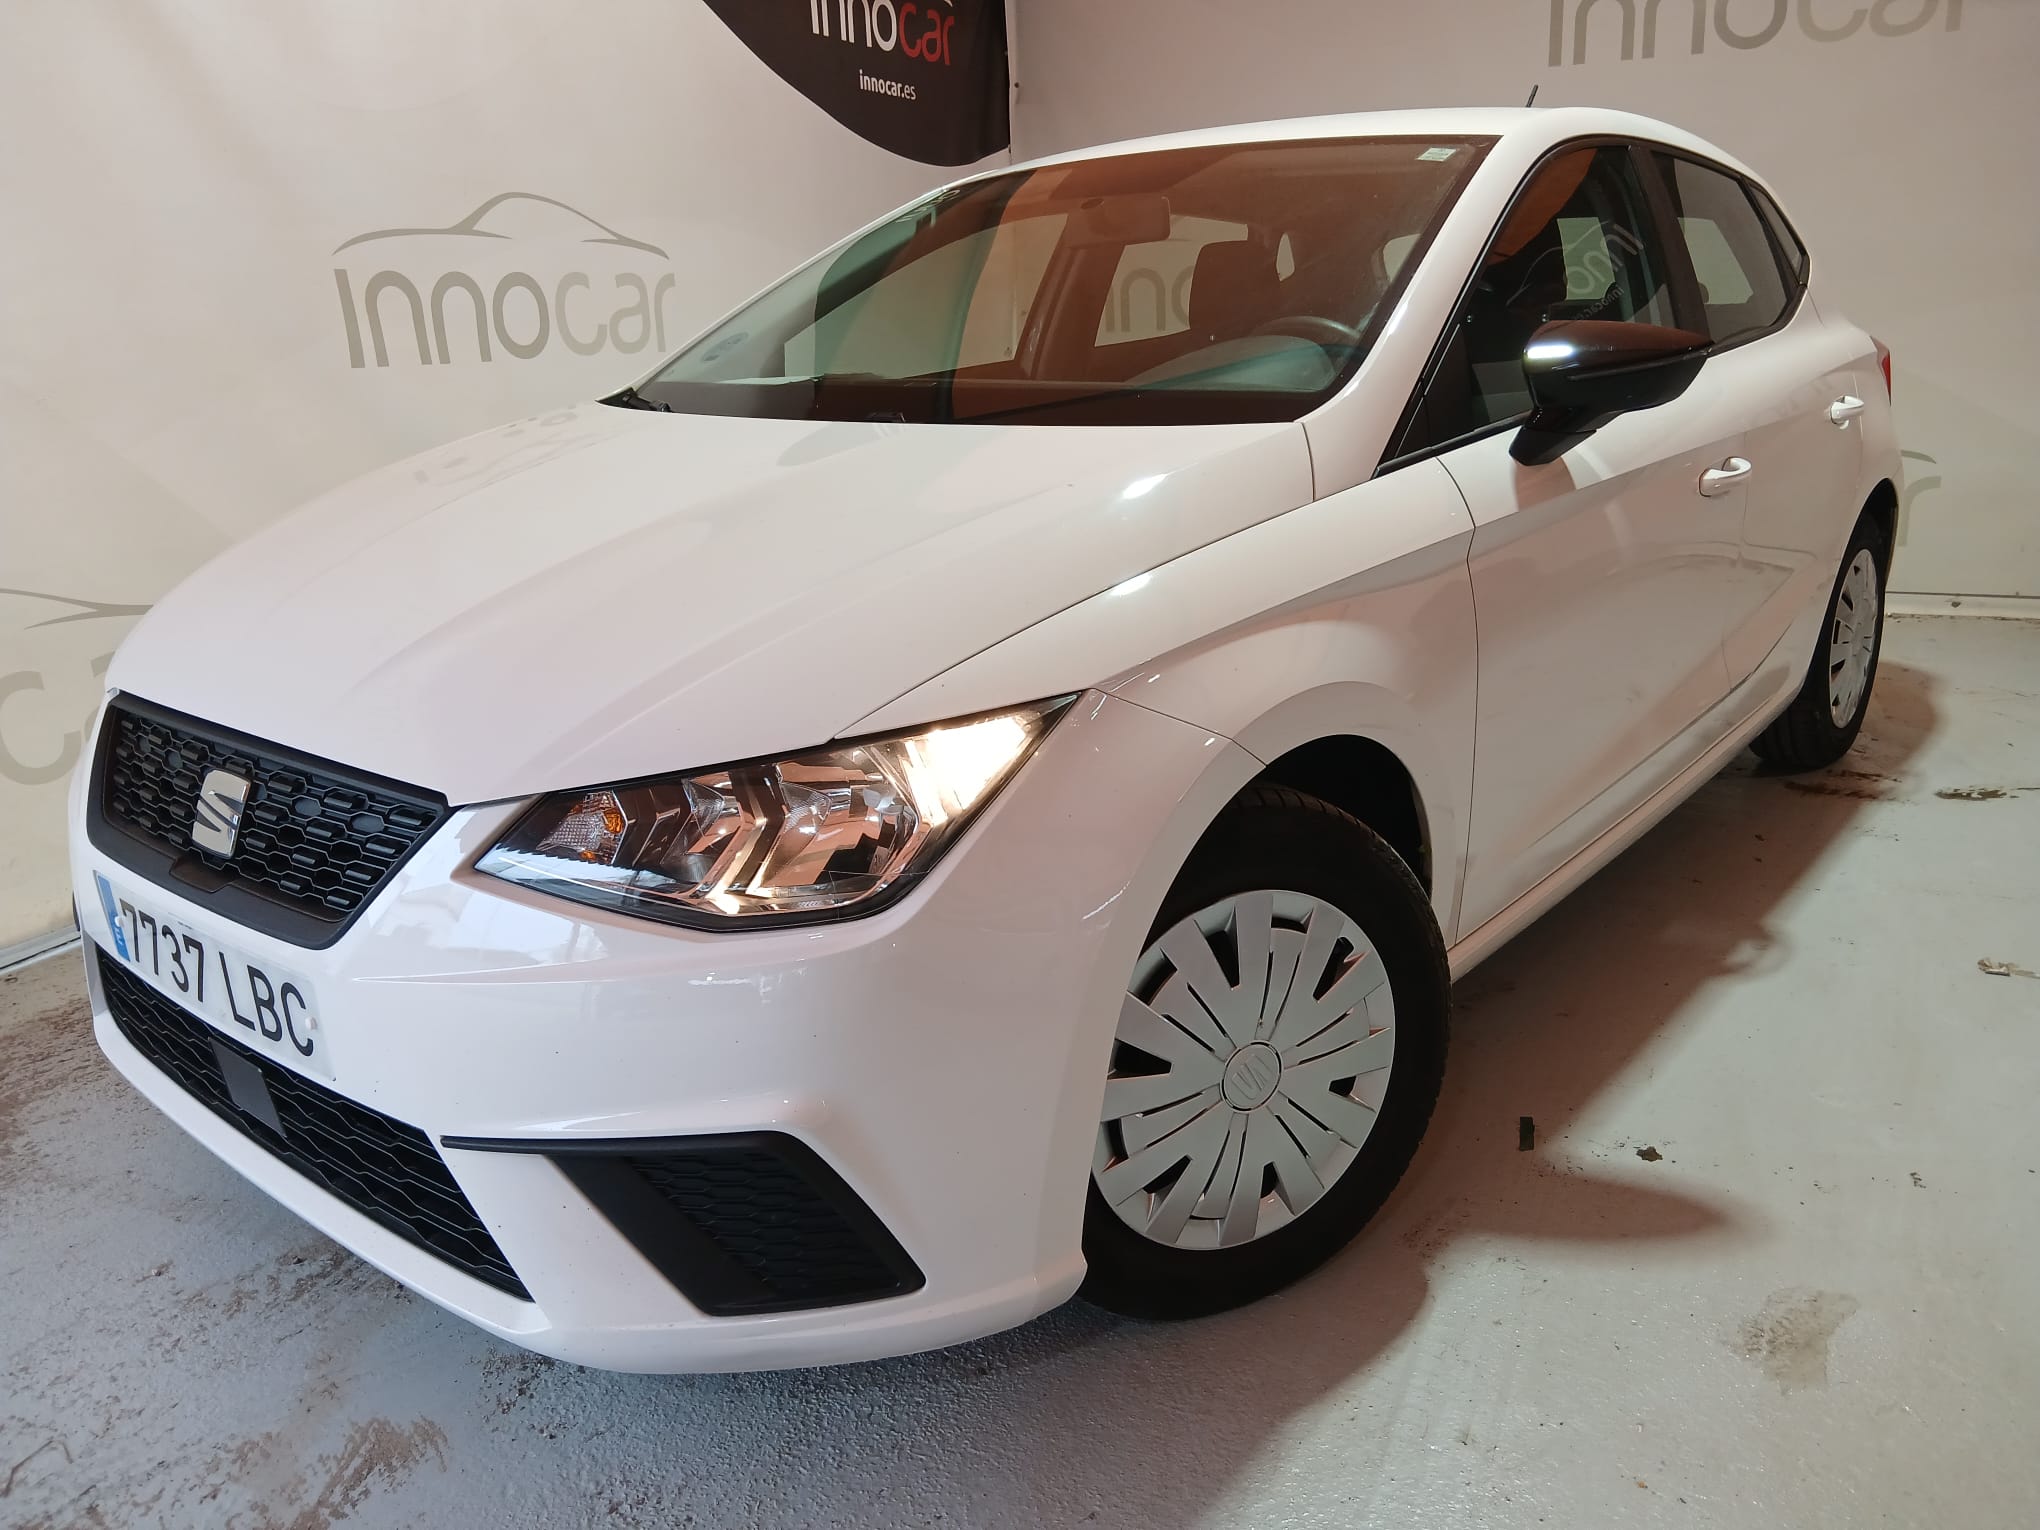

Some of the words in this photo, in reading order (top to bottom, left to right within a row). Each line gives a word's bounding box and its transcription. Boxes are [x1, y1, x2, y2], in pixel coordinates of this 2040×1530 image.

[859, 69, 917, 100] innocar.es
[119, 898, 204, 1003] 7737
[218, 951, 314, 1057] LBC
